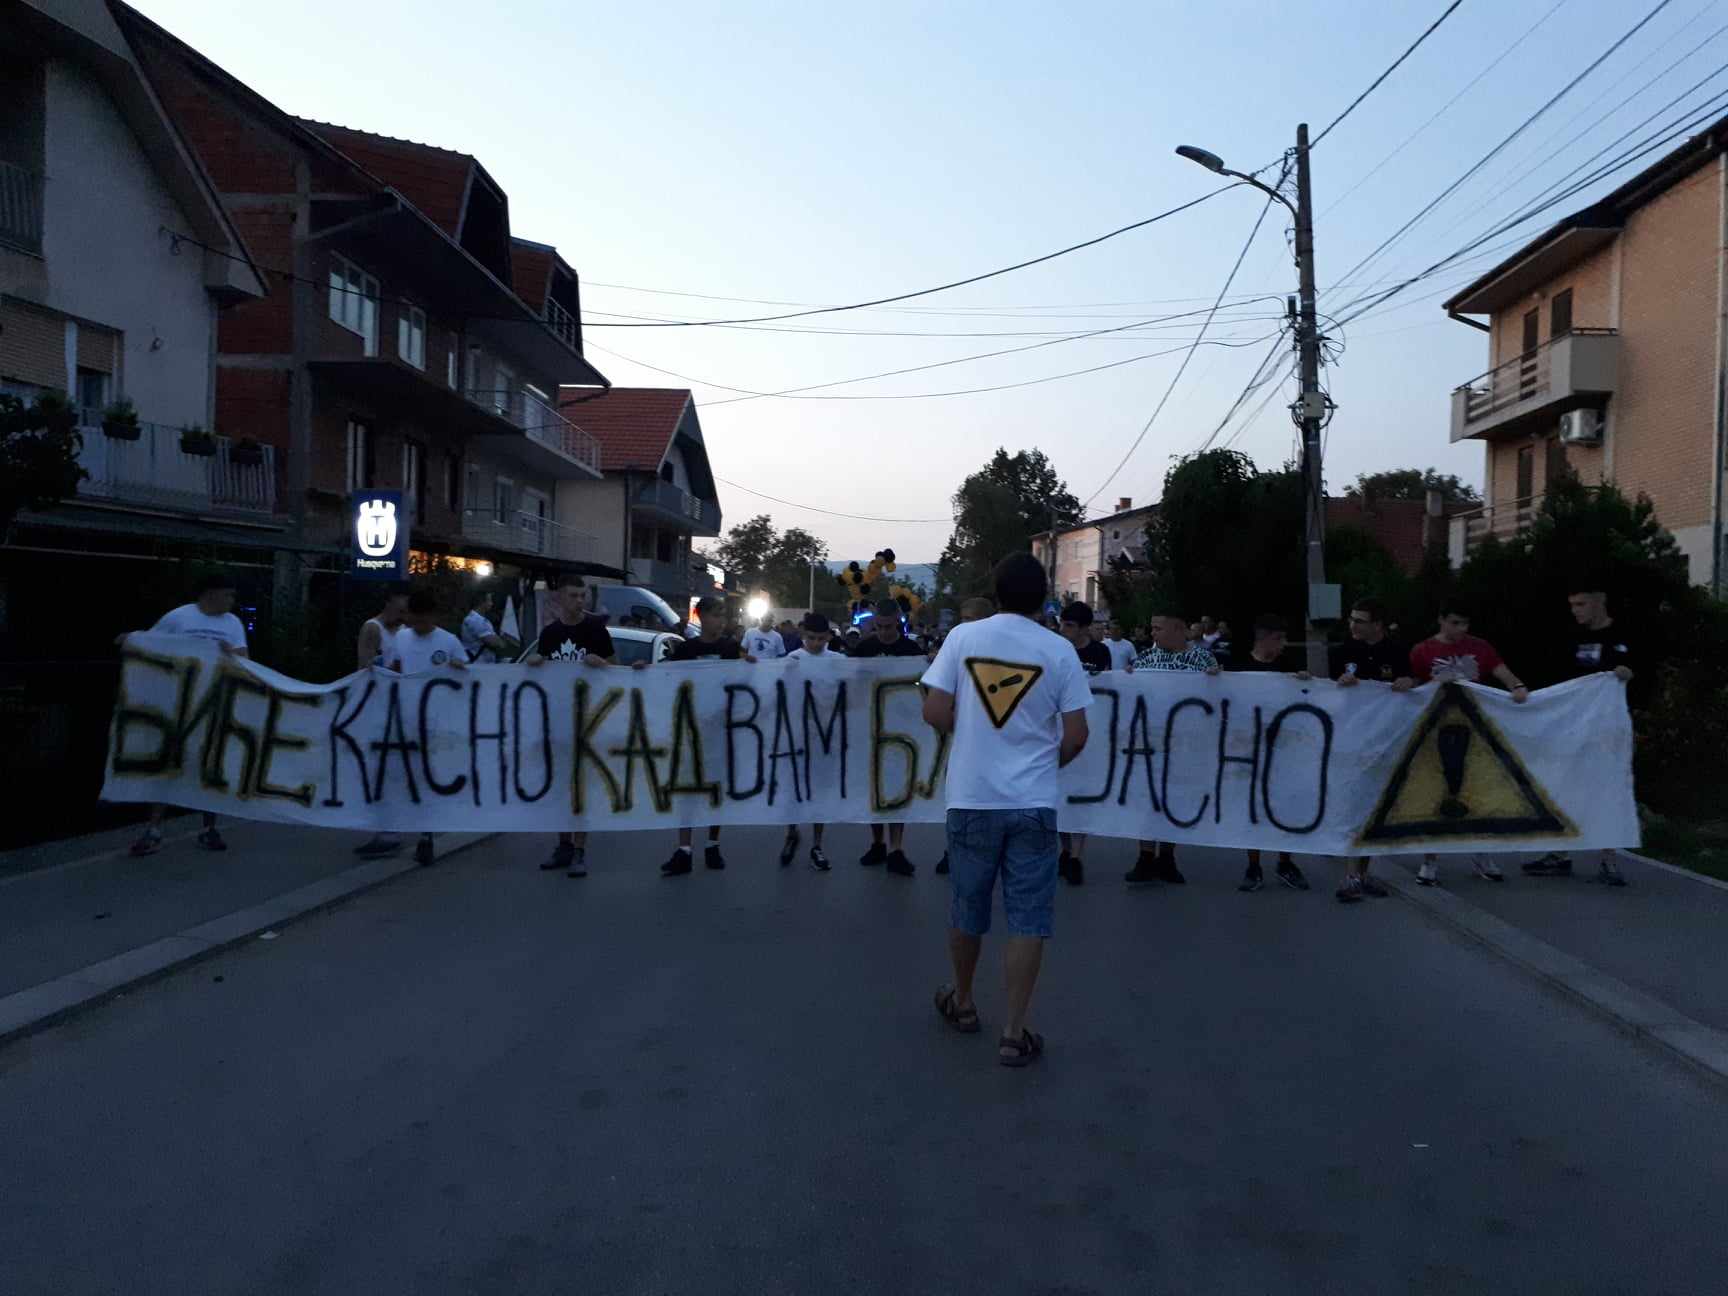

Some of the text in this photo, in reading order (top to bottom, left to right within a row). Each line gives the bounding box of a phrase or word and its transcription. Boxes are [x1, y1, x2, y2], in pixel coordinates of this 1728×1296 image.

[323, 677, 553, 807] КАСНО
[572, 679, 722, 815] КАД
[724, 678, 849, 806] ВАМ
[1066, 687, 1334, 835] ЈАСНО
